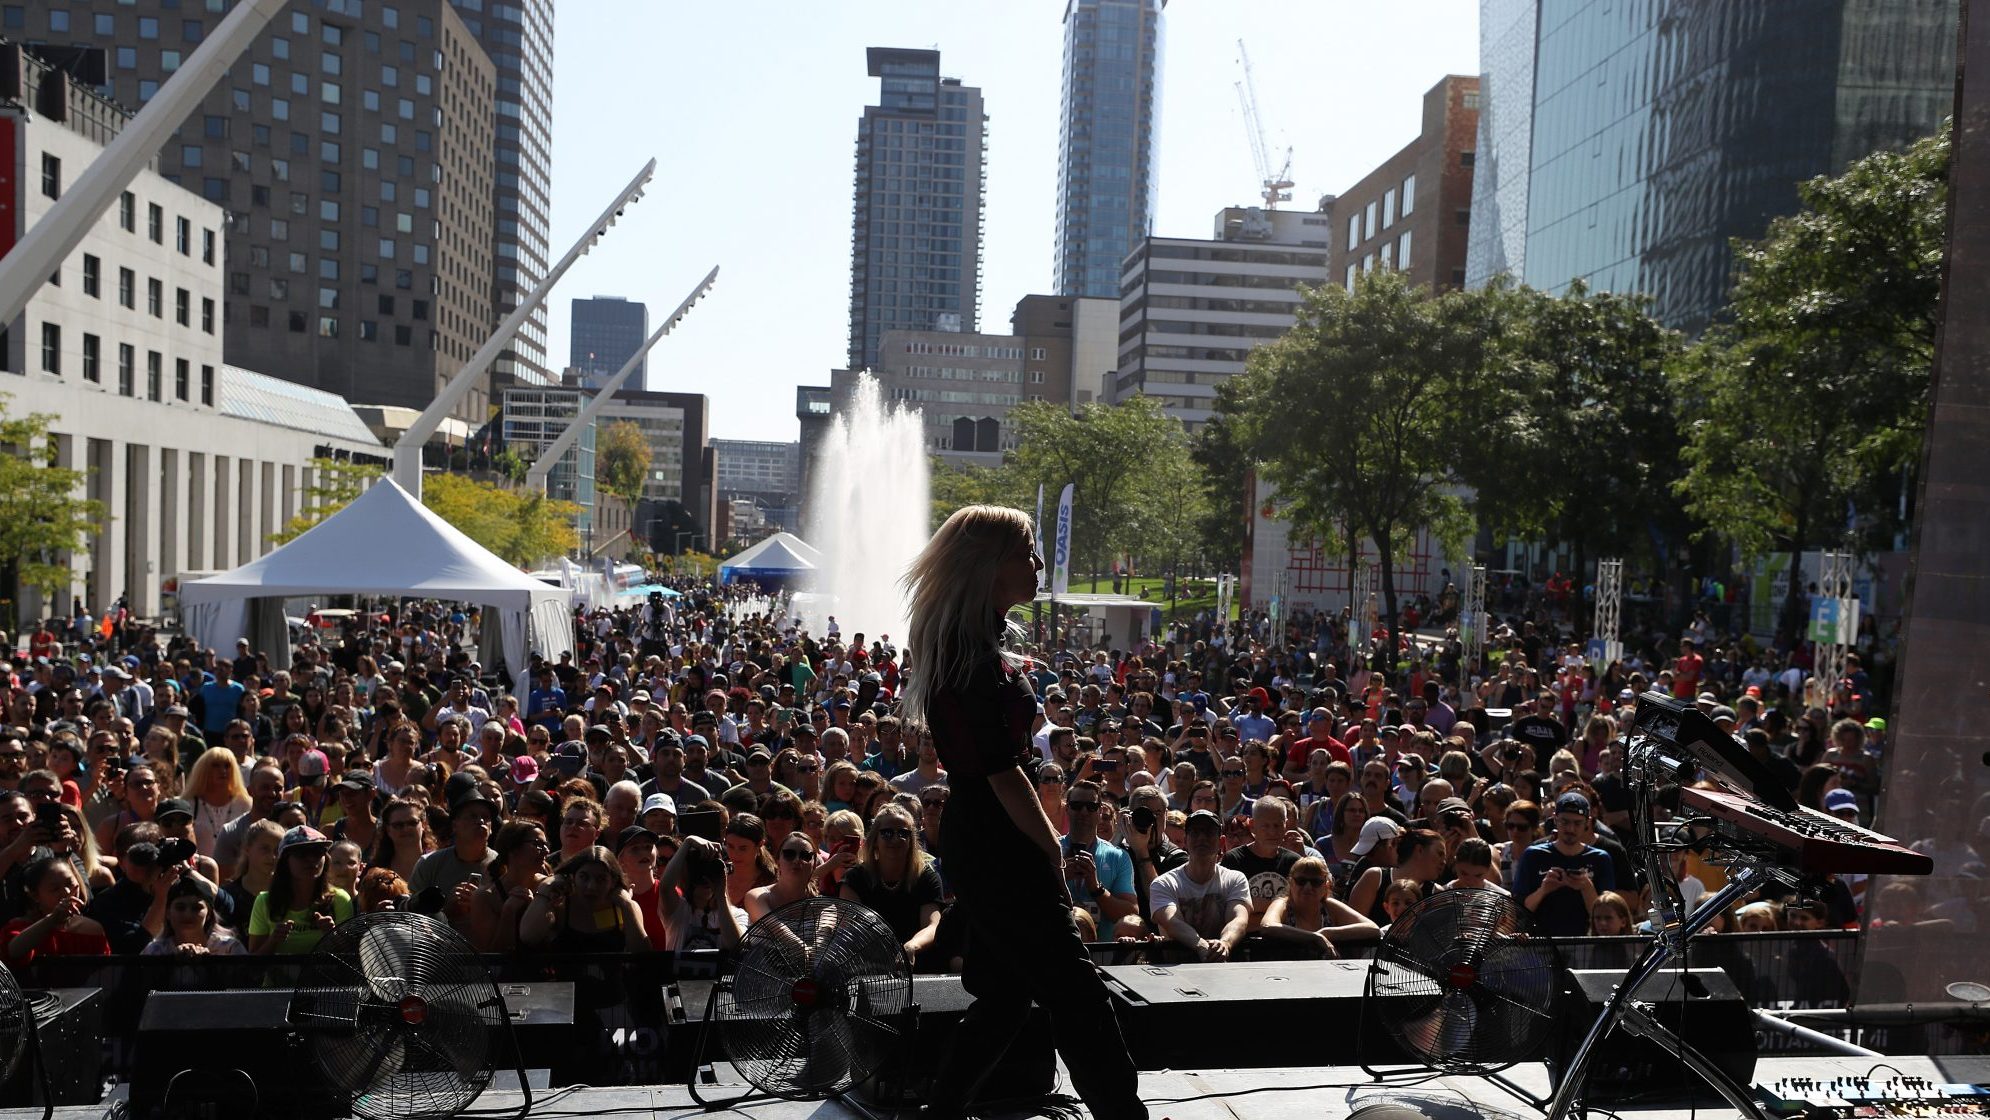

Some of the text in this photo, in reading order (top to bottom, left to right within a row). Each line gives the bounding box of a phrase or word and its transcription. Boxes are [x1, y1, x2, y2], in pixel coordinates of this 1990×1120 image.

[1055, 503, 1069, 566] OASIS
[1816, 601, 1831, 636] É
[1697, 747, 1724, 768] Roland
